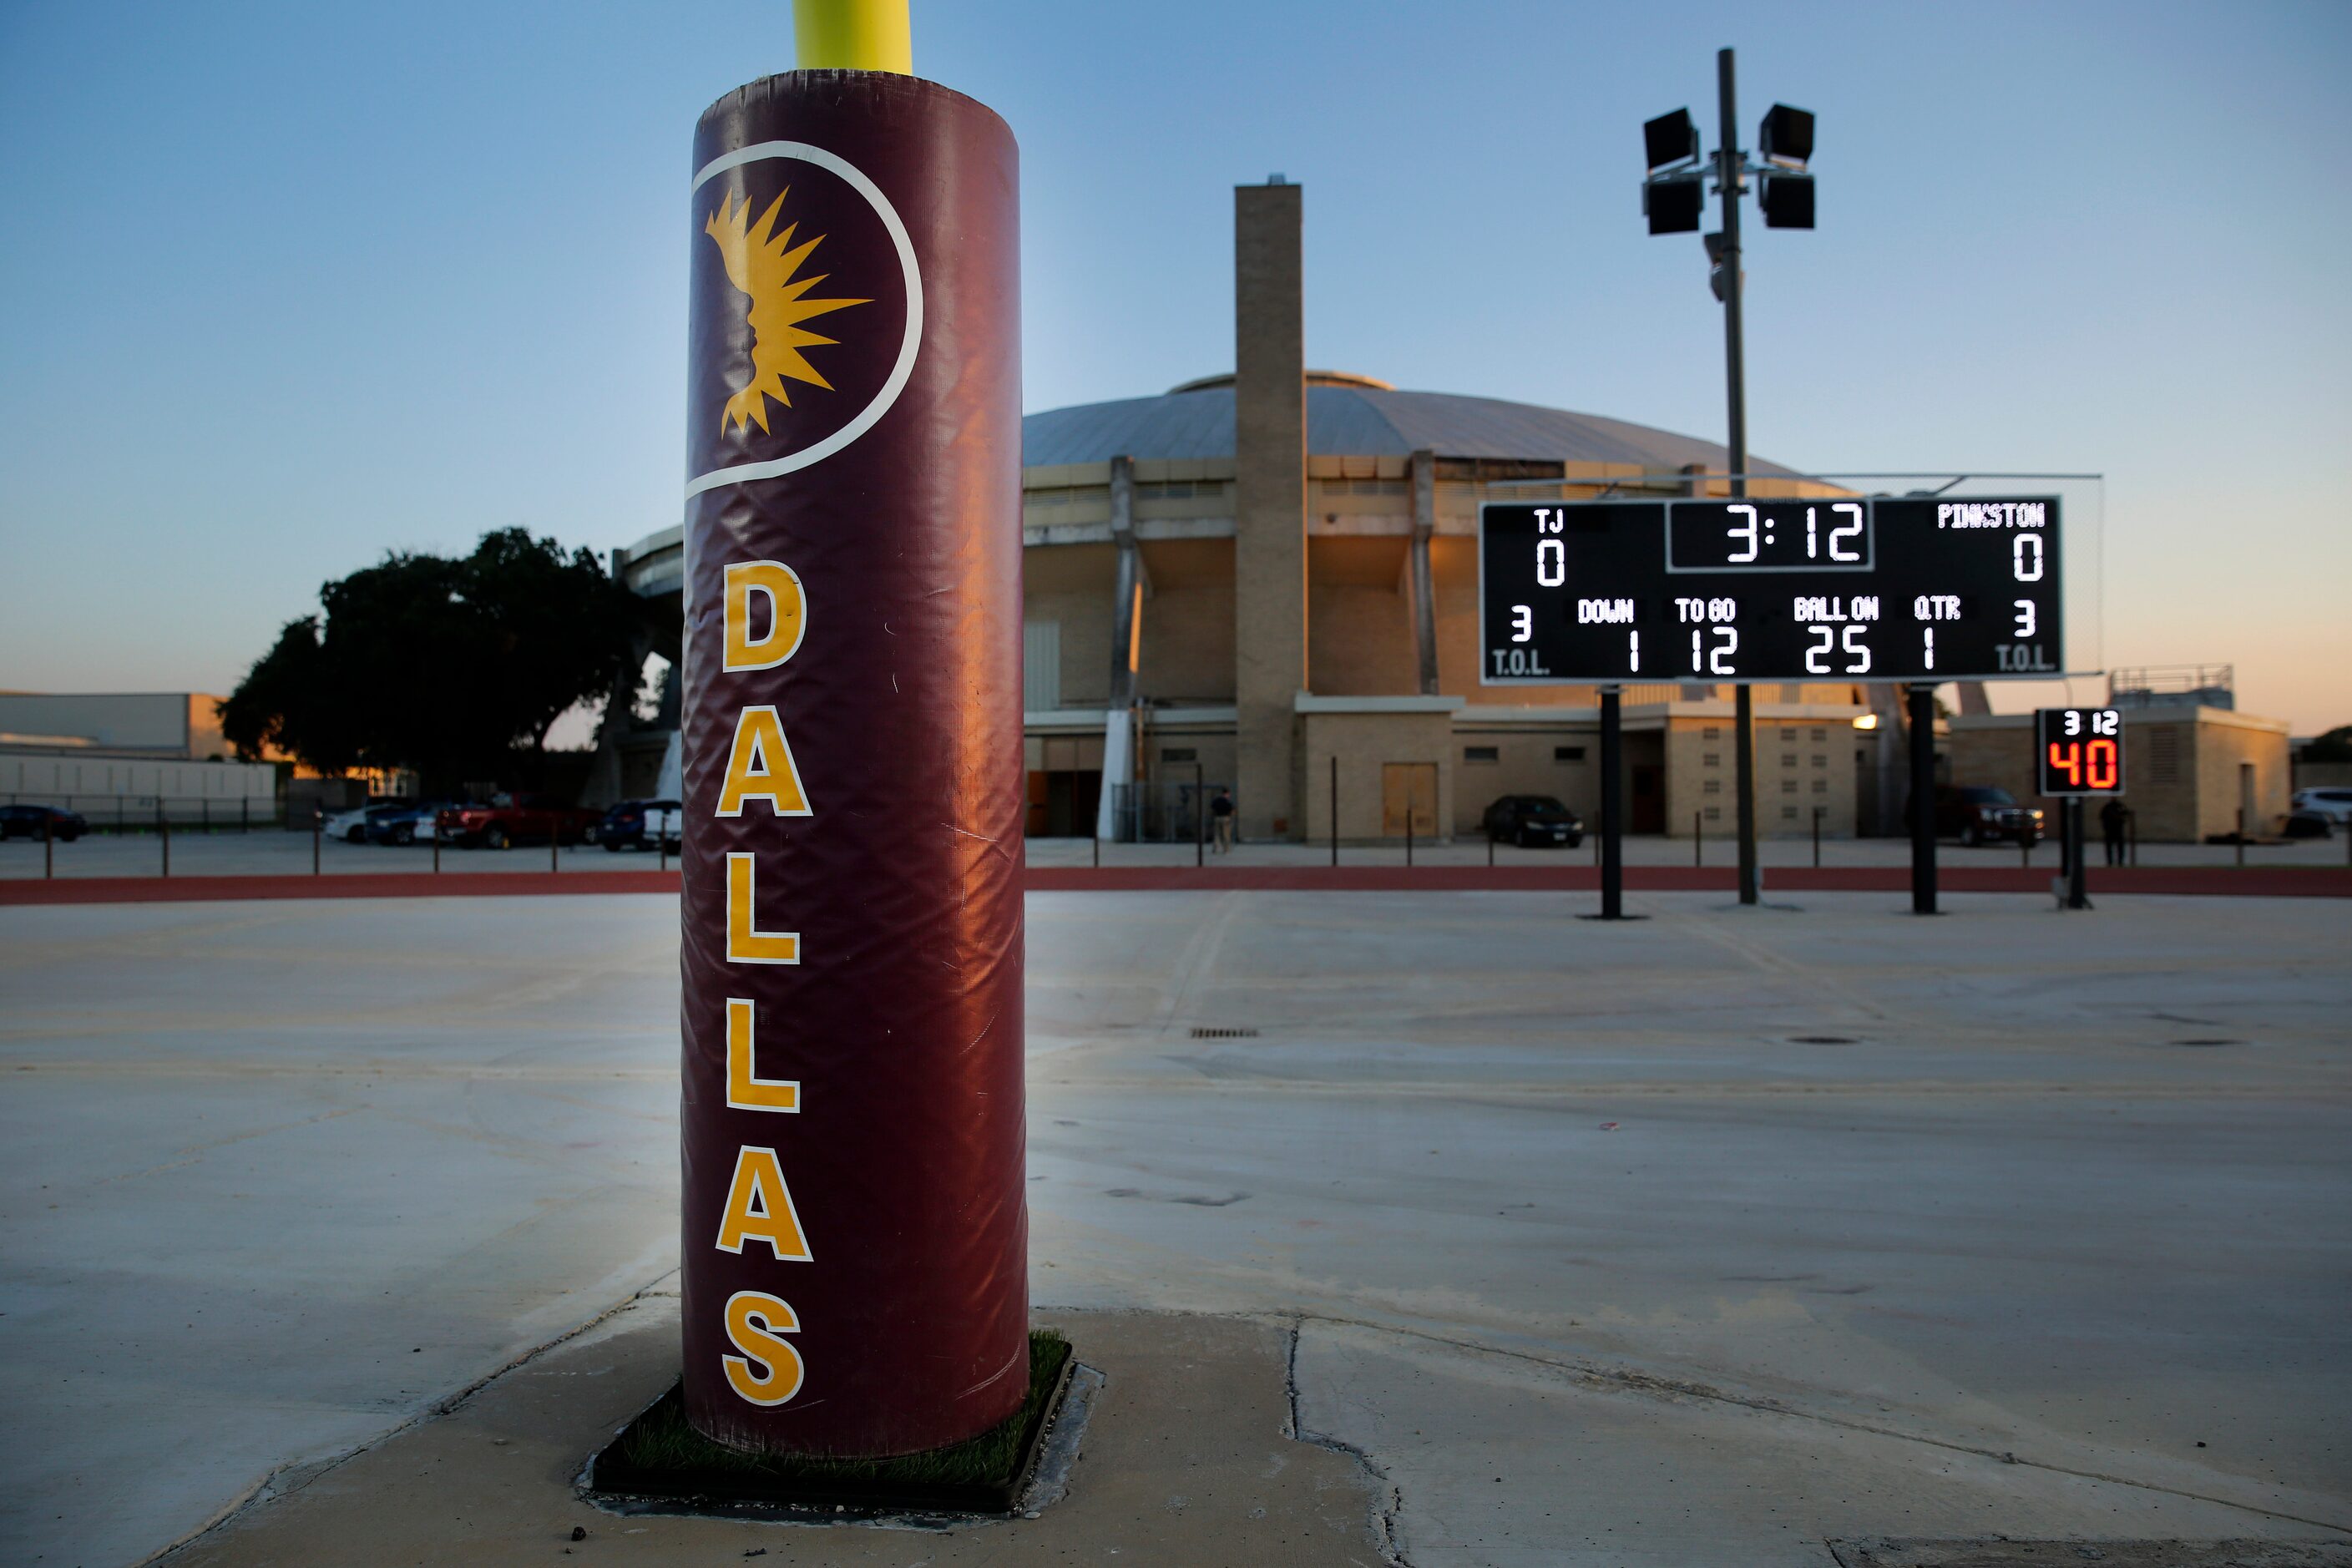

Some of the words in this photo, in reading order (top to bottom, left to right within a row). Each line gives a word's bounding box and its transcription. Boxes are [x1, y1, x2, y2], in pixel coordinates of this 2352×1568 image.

[1533, 508, 1564, 534] TJ
[1725, 504, 1863, 563] 3:12
[1937, 503, 2046, 529] PINKSTON
[1536, 539, 1565, 587] 0
[2013, 533, 2044, 582] 0
[1511, 604, 1532, 642] 3
[1577, 598, 1634, 624] DOWN
[1793, 596, 1848, 622] BALL
[1850, 595, 1879, 621] ON
[1914, 594, 1961, 620] QTR
[2013, 599, 2036, 637] 3
[1491, 648, 1551, 675] T.O.L.
[1629, 629, 1639, 673] 1
[1692, 625, 1738, 674] 12
[1805, 625, 1872, 674] 25
[1924, 626, 1934, 670] 1
[1995, 644, 2056, 671] T.O.L.
[2049, 739, 2117, 789] 40
[715, 559, 814, 1407] DALLAS
